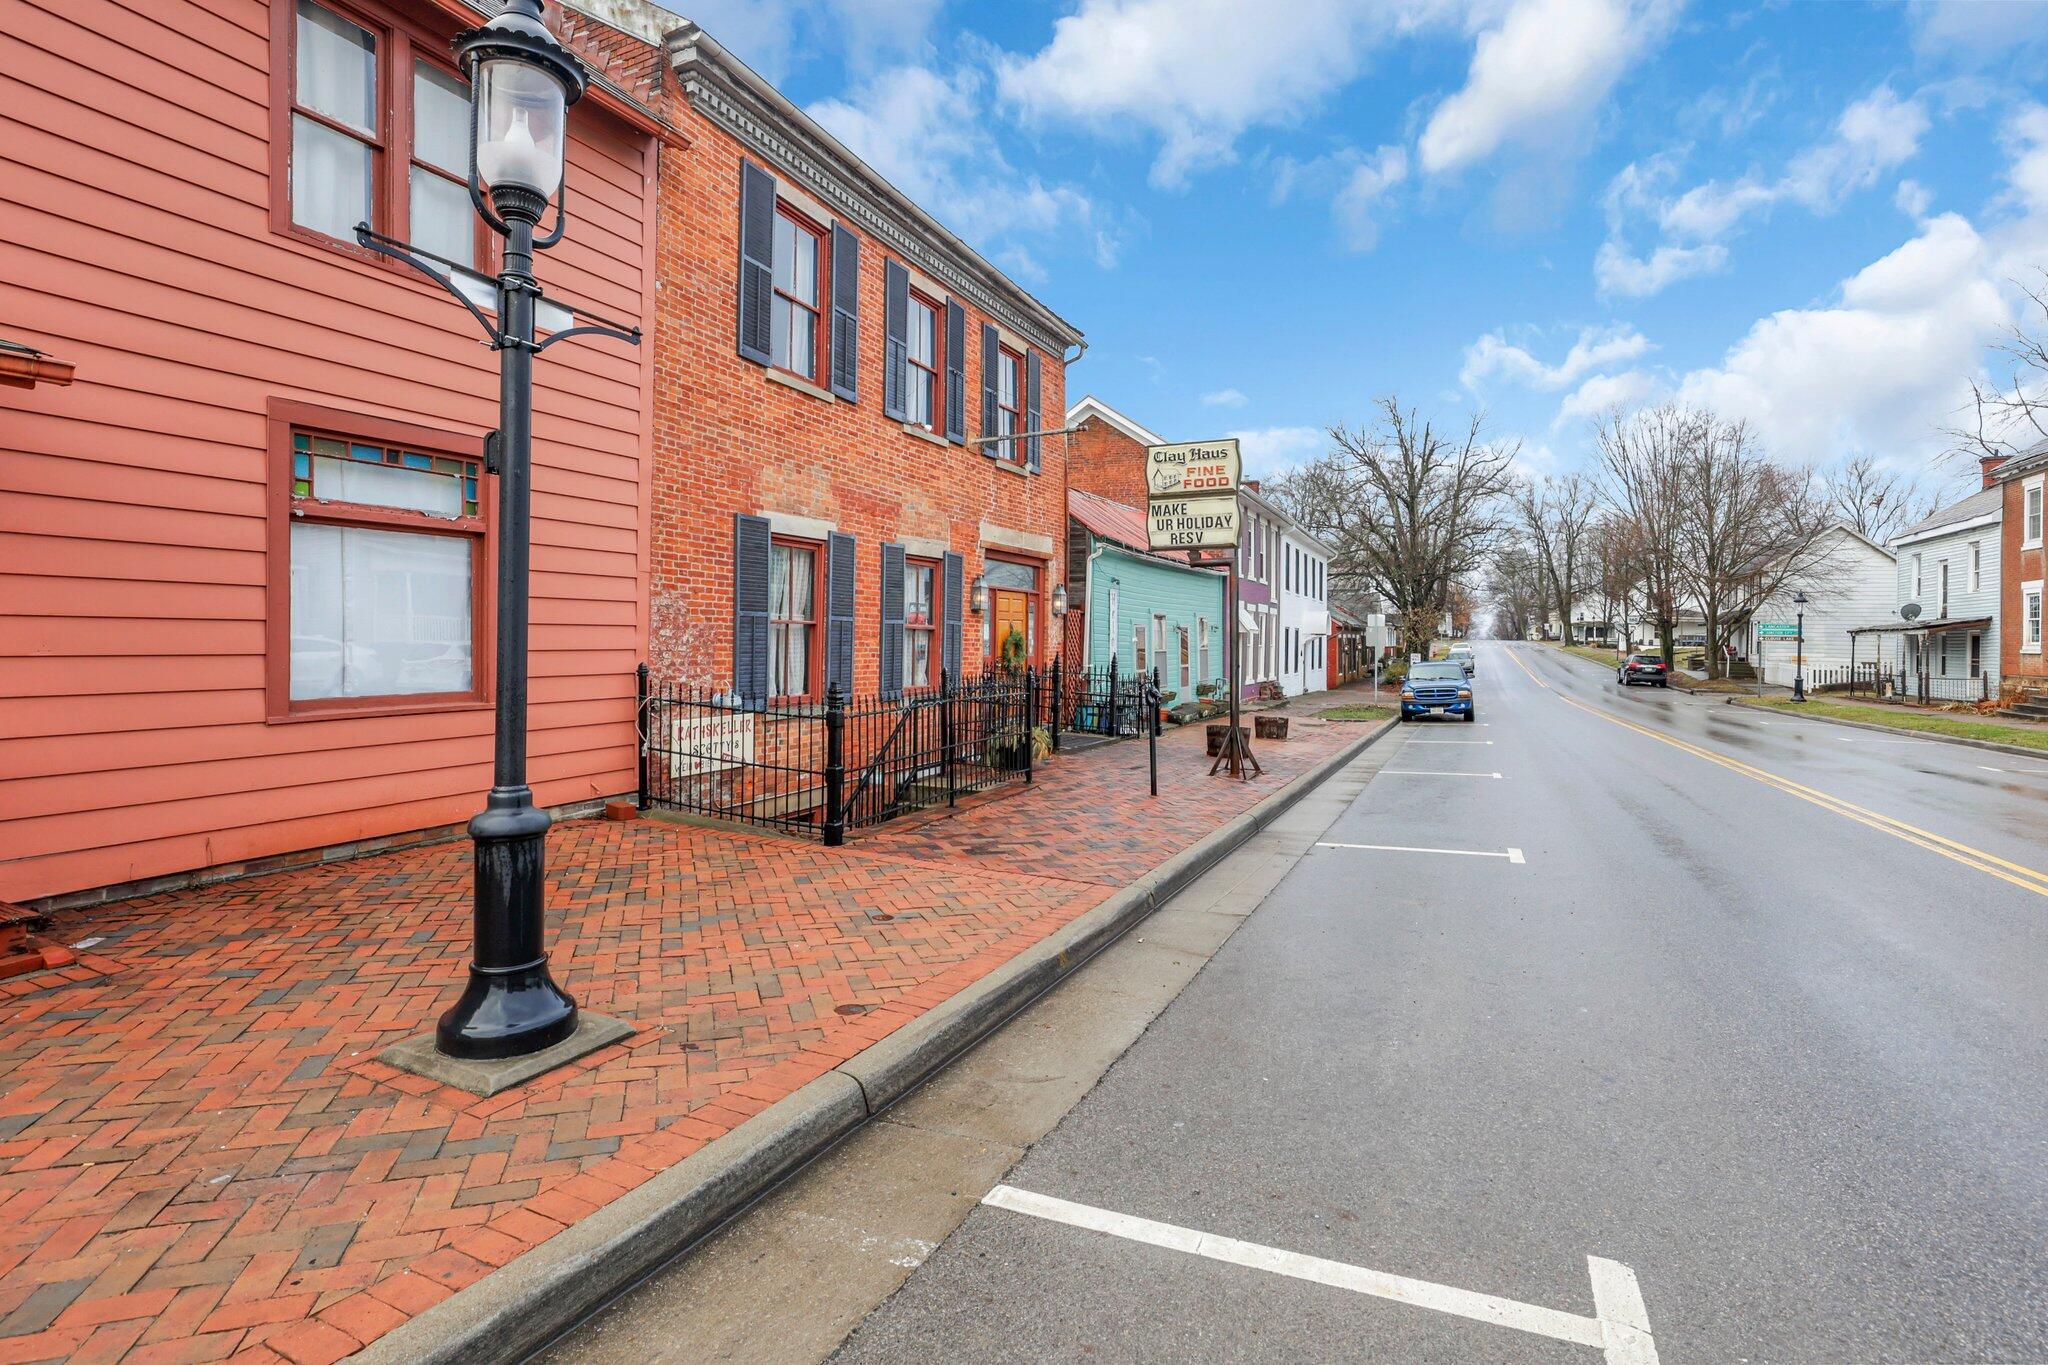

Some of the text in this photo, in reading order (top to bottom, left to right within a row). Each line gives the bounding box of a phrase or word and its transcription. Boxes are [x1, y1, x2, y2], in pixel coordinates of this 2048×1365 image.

[1153, 448, 1228, 466] Clay Haus
[1187, 465, 1226, 477] FINE
[1183, 477, 1229, 489] FOOD
[1151, 503, 1187, 517] MAKE
[1156, 515, 1232, 531] UR HOLIDAY
[1170, 532, 1203, 545] RESV
[674, 761, 692, 773] WEI
